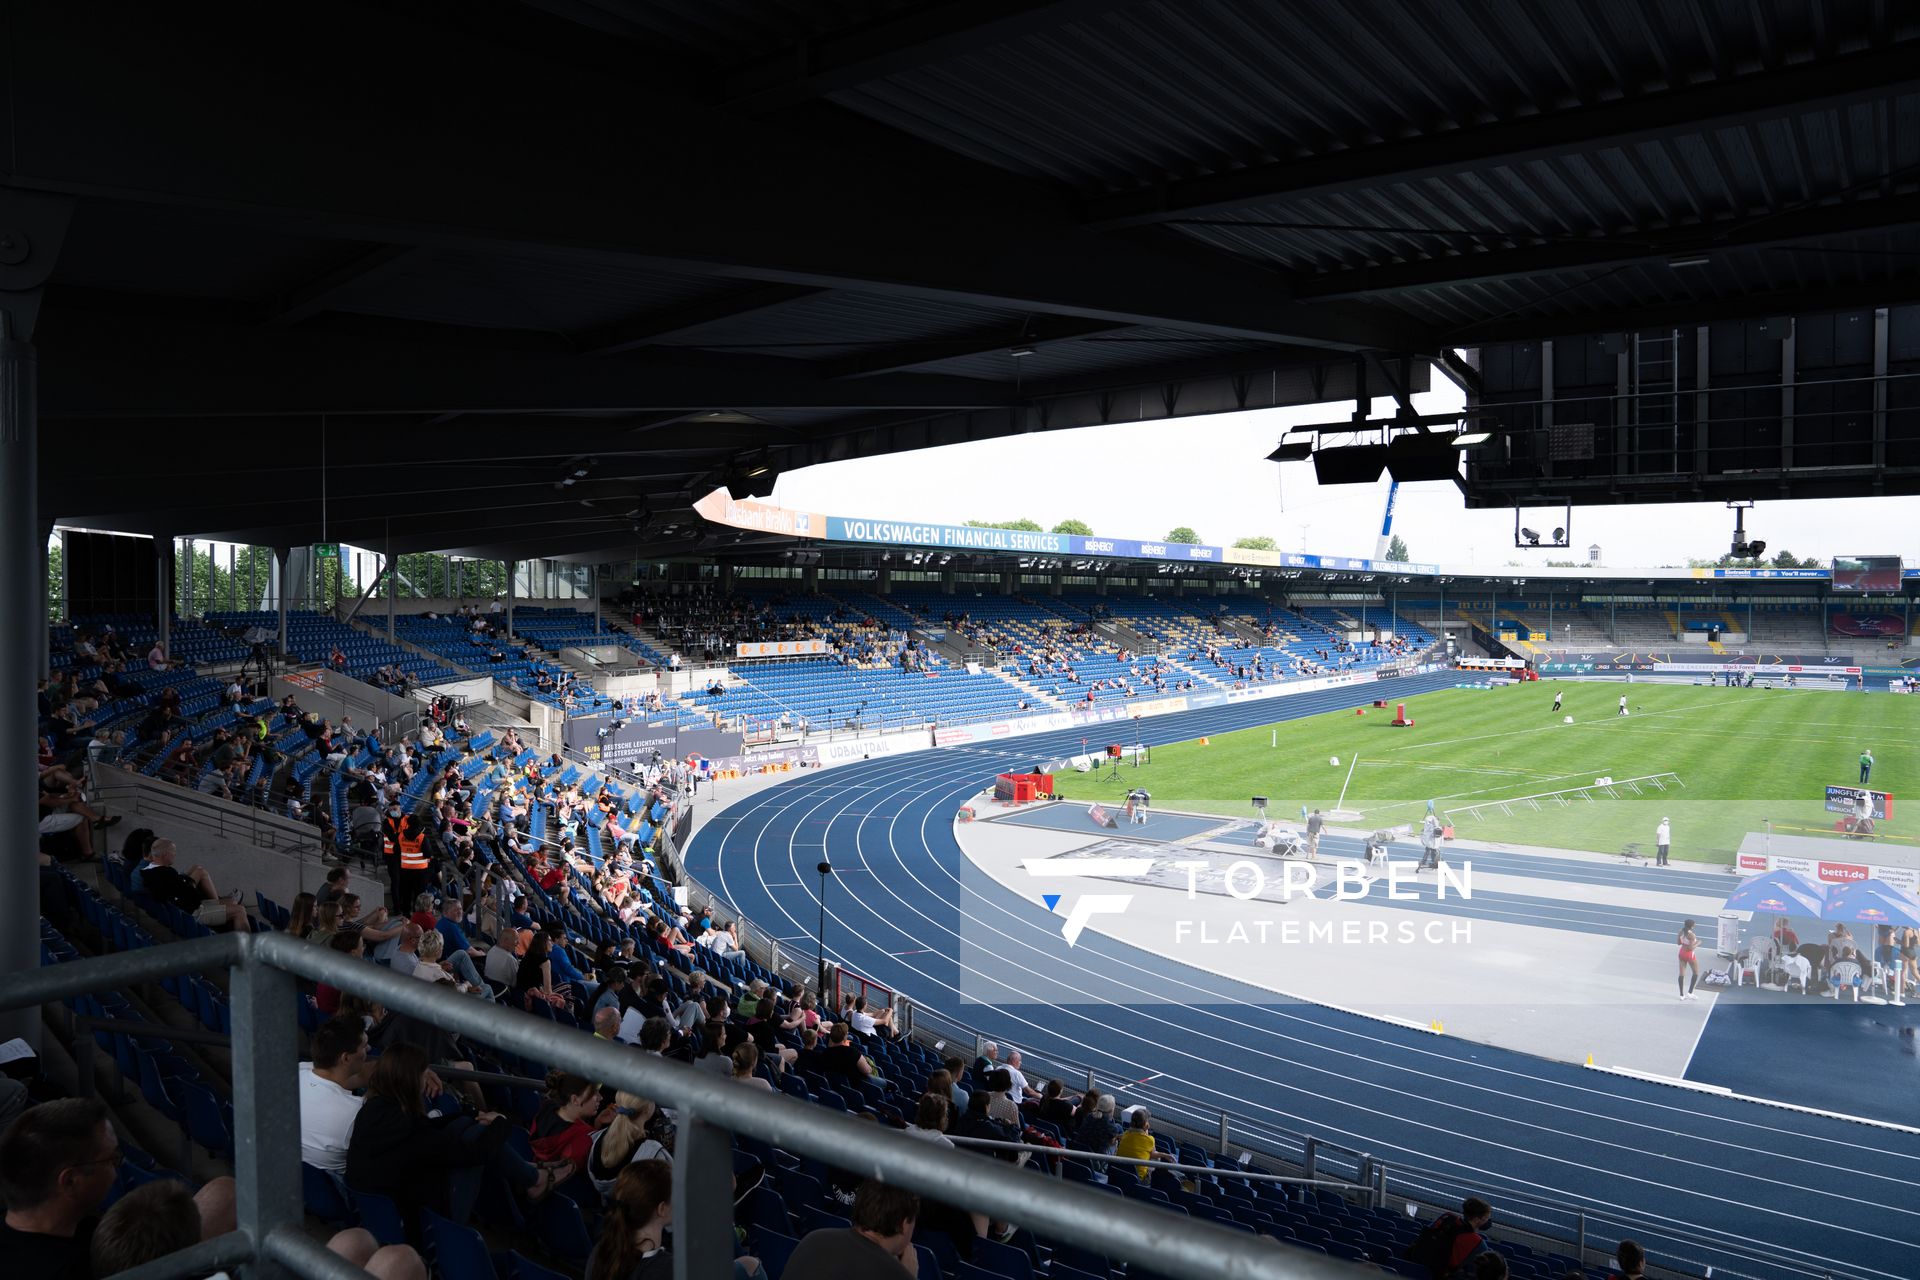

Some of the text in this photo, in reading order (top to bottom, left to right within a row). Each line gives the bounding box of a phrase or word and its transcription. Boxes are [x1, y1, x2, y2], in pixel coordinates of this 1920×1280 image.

[843, 520, 1059, 551] VOLKSWAGEN FINANCIAL SERVICES
[633, 737, 677, 748] LEICHTATHLETIK
[829, 740, 890, 759] URBAN TRAIL
[1827, 787, 1875, 799] JUNGFLEH
[1821, 867, 1865, 880] bett1.de
